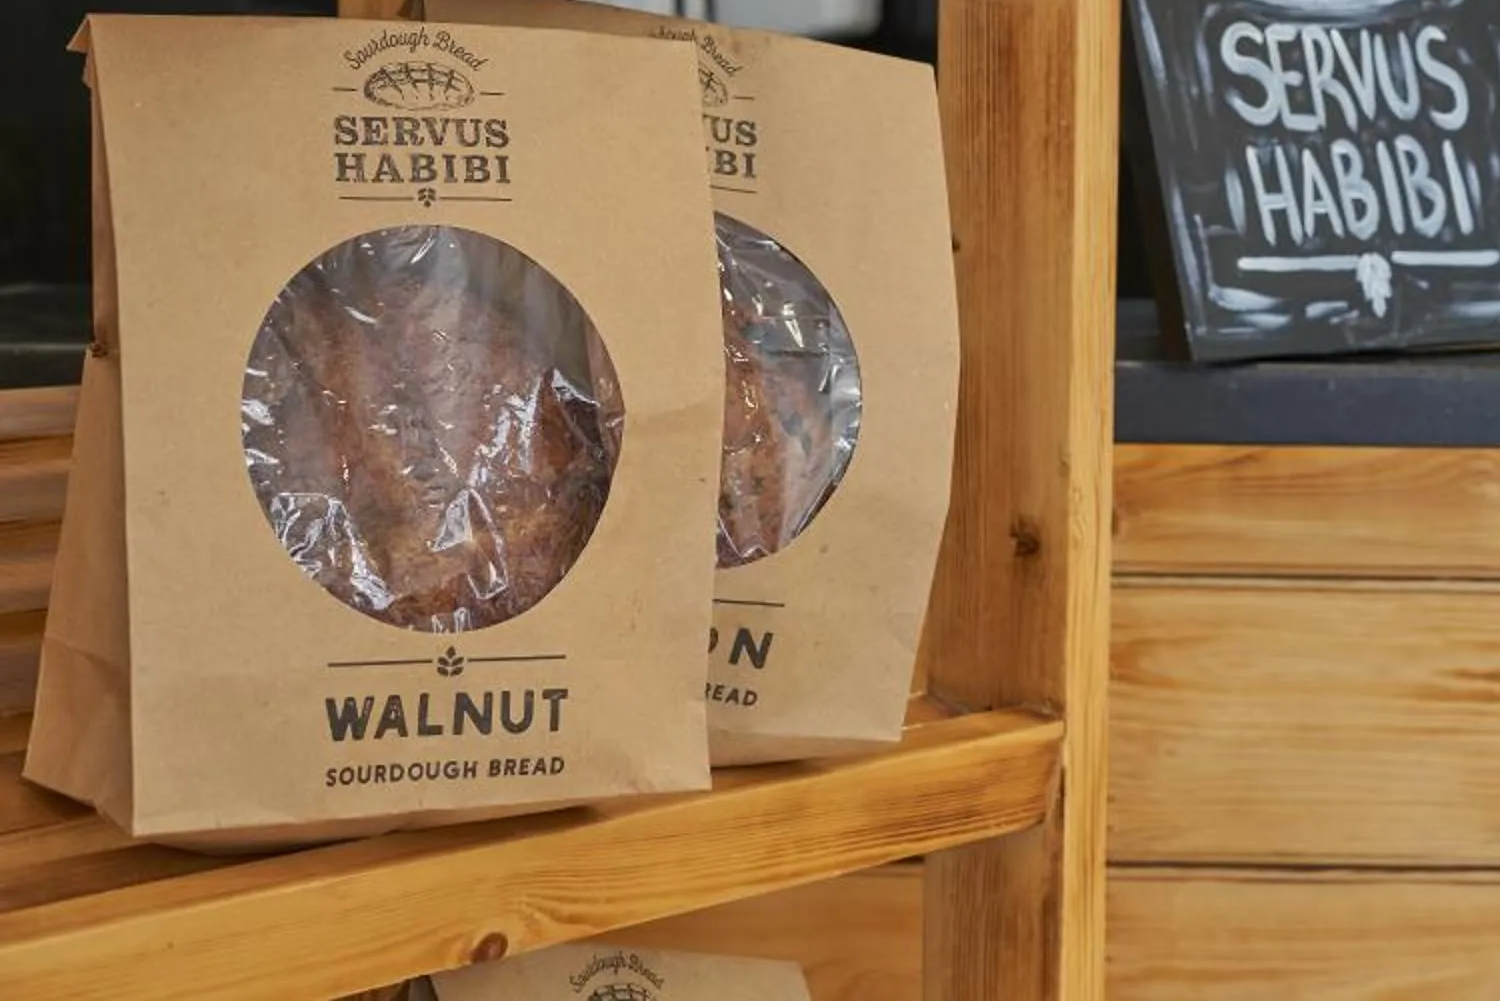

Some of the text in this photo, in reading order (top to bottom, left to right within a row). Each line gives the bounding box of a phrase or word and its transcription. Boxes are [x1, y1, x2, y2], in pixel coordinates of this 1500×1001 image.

[343, 26, 489, 71] Sourdough Bread
[1220, 22, 1470, 132] SERVUS
[334, 115, 510, 149] SERVUS
[334, 152, 511, 184] HABIBI
[1246, 134, 1474, 245] HABIBI
[705, 683, 758, 707] EAD
[325, 688, 570, 743] WALNUT
[325, 755, 566, 788] SOURDOUGH BREAD
